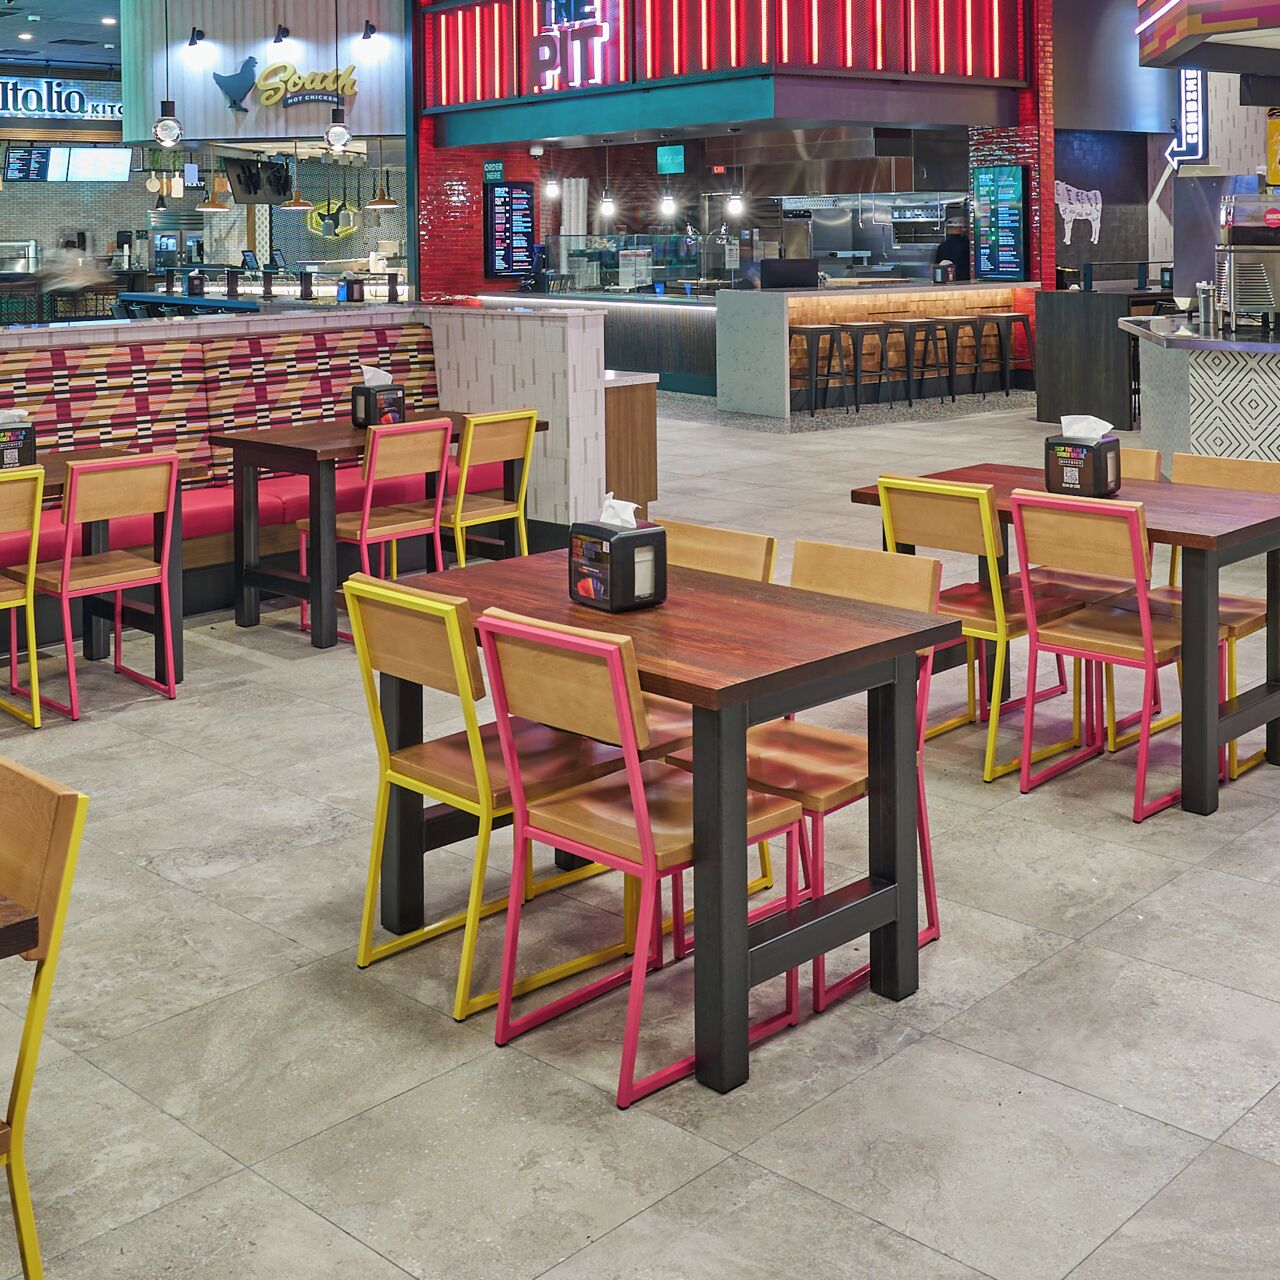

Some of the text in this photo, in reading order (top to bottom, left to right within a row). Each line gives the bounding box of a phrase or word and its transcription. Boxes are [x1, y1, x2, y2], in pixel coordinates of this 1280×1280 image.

[530, 25, 604, 93] PIT
[256, 62, 359, 107] South
[0, 80, 88, 114] Italia
[287, 94, 339, 104] HOT CHICKEN
[484, 163, 503, 172] ORDER
[486, 171, 501, 180] HERE
